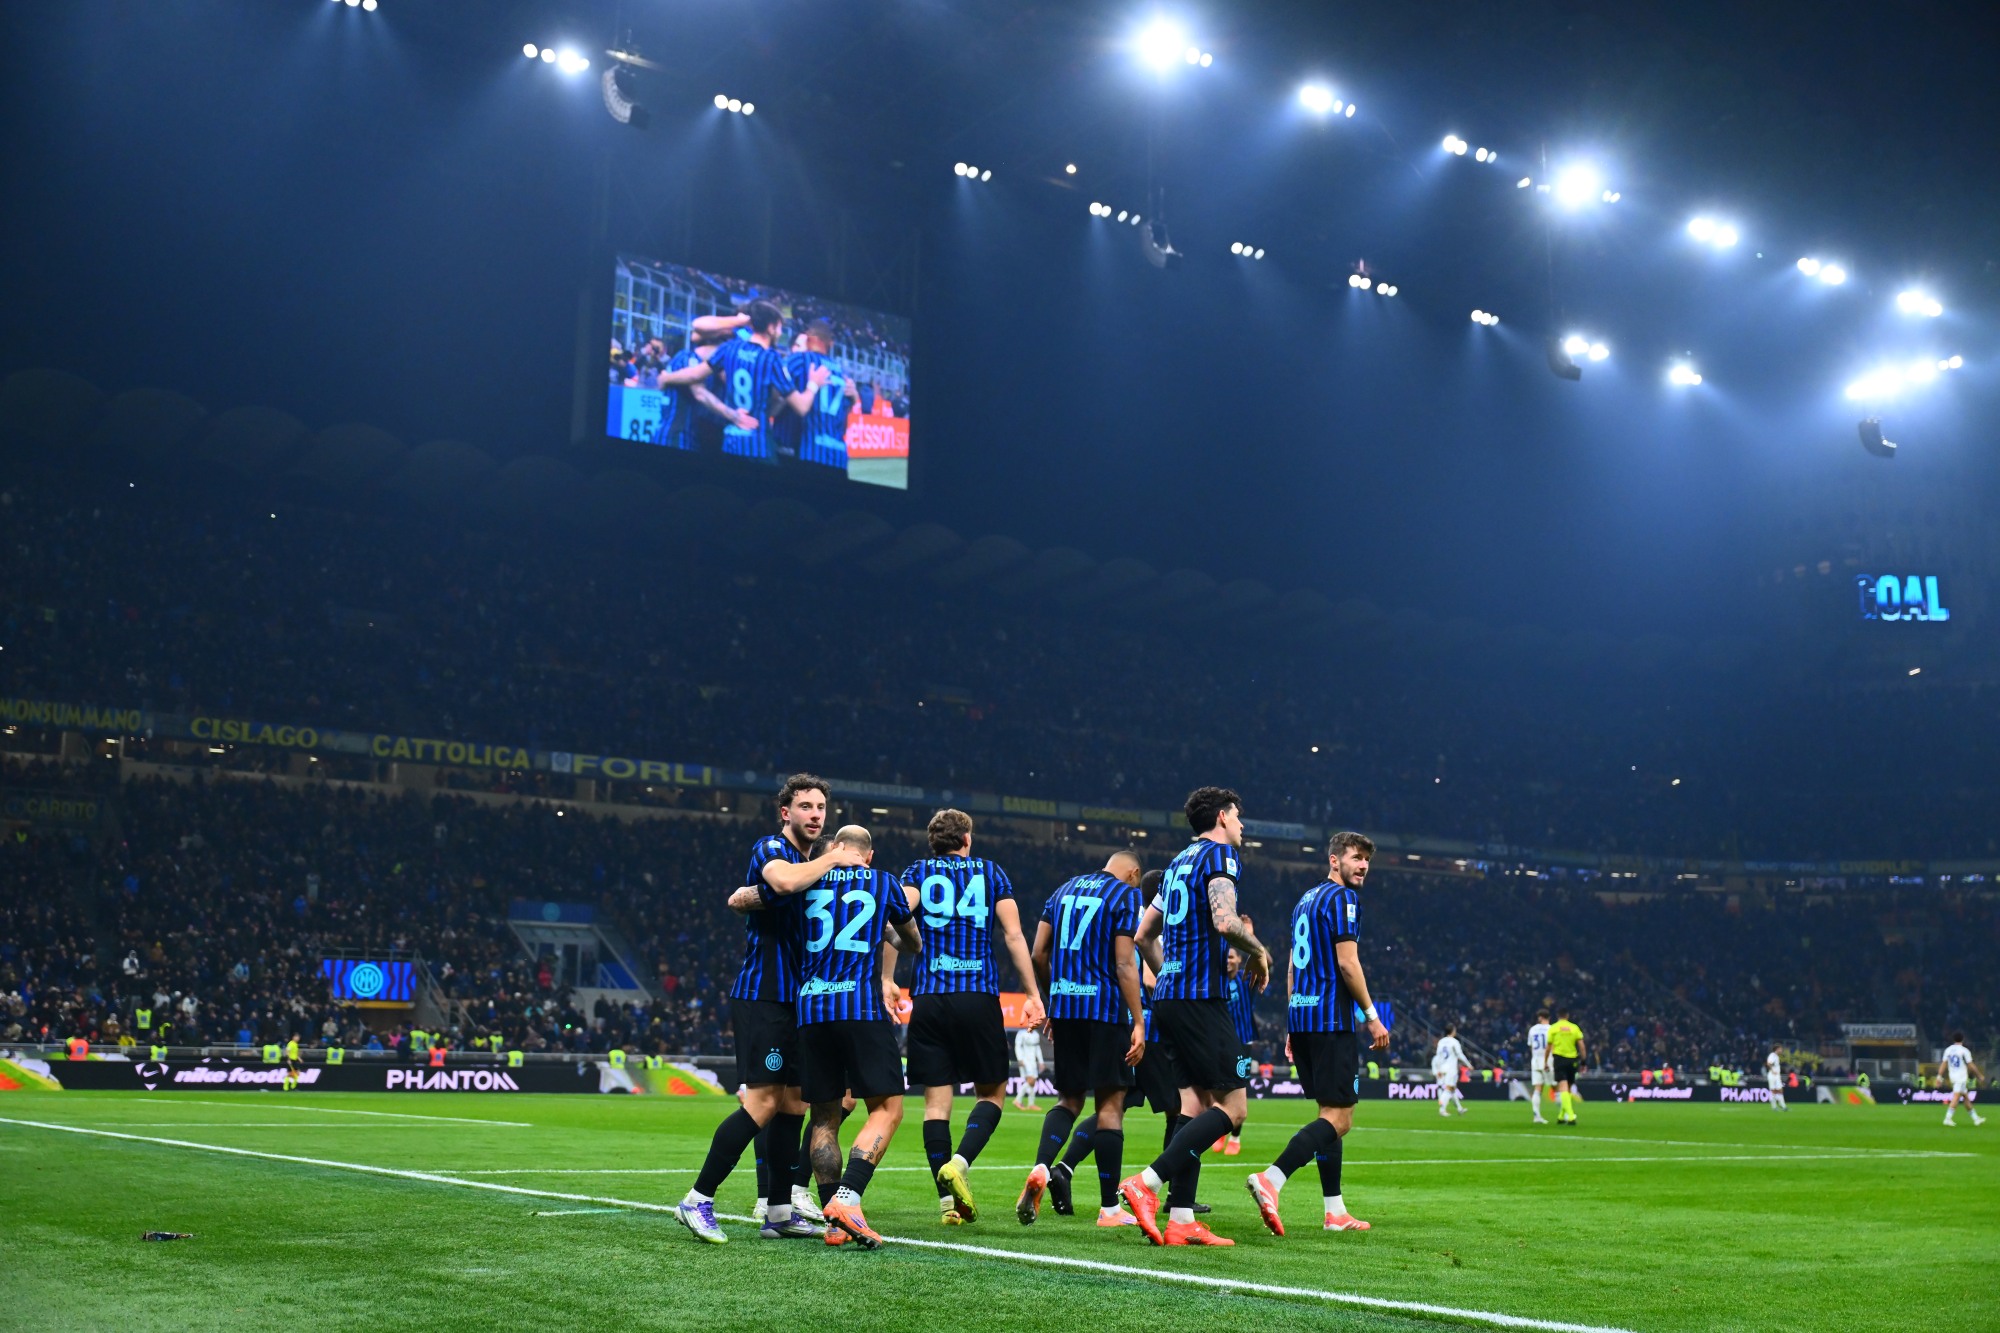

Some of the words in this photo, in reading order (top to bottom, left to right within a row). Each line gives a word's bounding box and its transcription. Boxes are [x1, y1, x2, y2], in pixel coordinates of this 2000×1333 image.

[733, 368, 752, 412] 8
[846, 416, 894, 450] etsson
[191, 717, 318, 748] CISLAGO
[372, 734, 530, 769] CATTOLICA
[574, 754, 712, 787] FORLI
[920, 874, 988, 928] 94
[1075, 879, 1104, 889] DIOUF
[805, 889, 876, 952] 32
[1060, 895, 1103, 951] 17
[1293, 913, 1310, 969] 8
[174, 1067, 227, 1083] nike
[228, 1067, 321, 1083] footll
[386, 1069, 519, 1090] PHANTOM
[1388, 1083, 1464, 1099] PHANT
